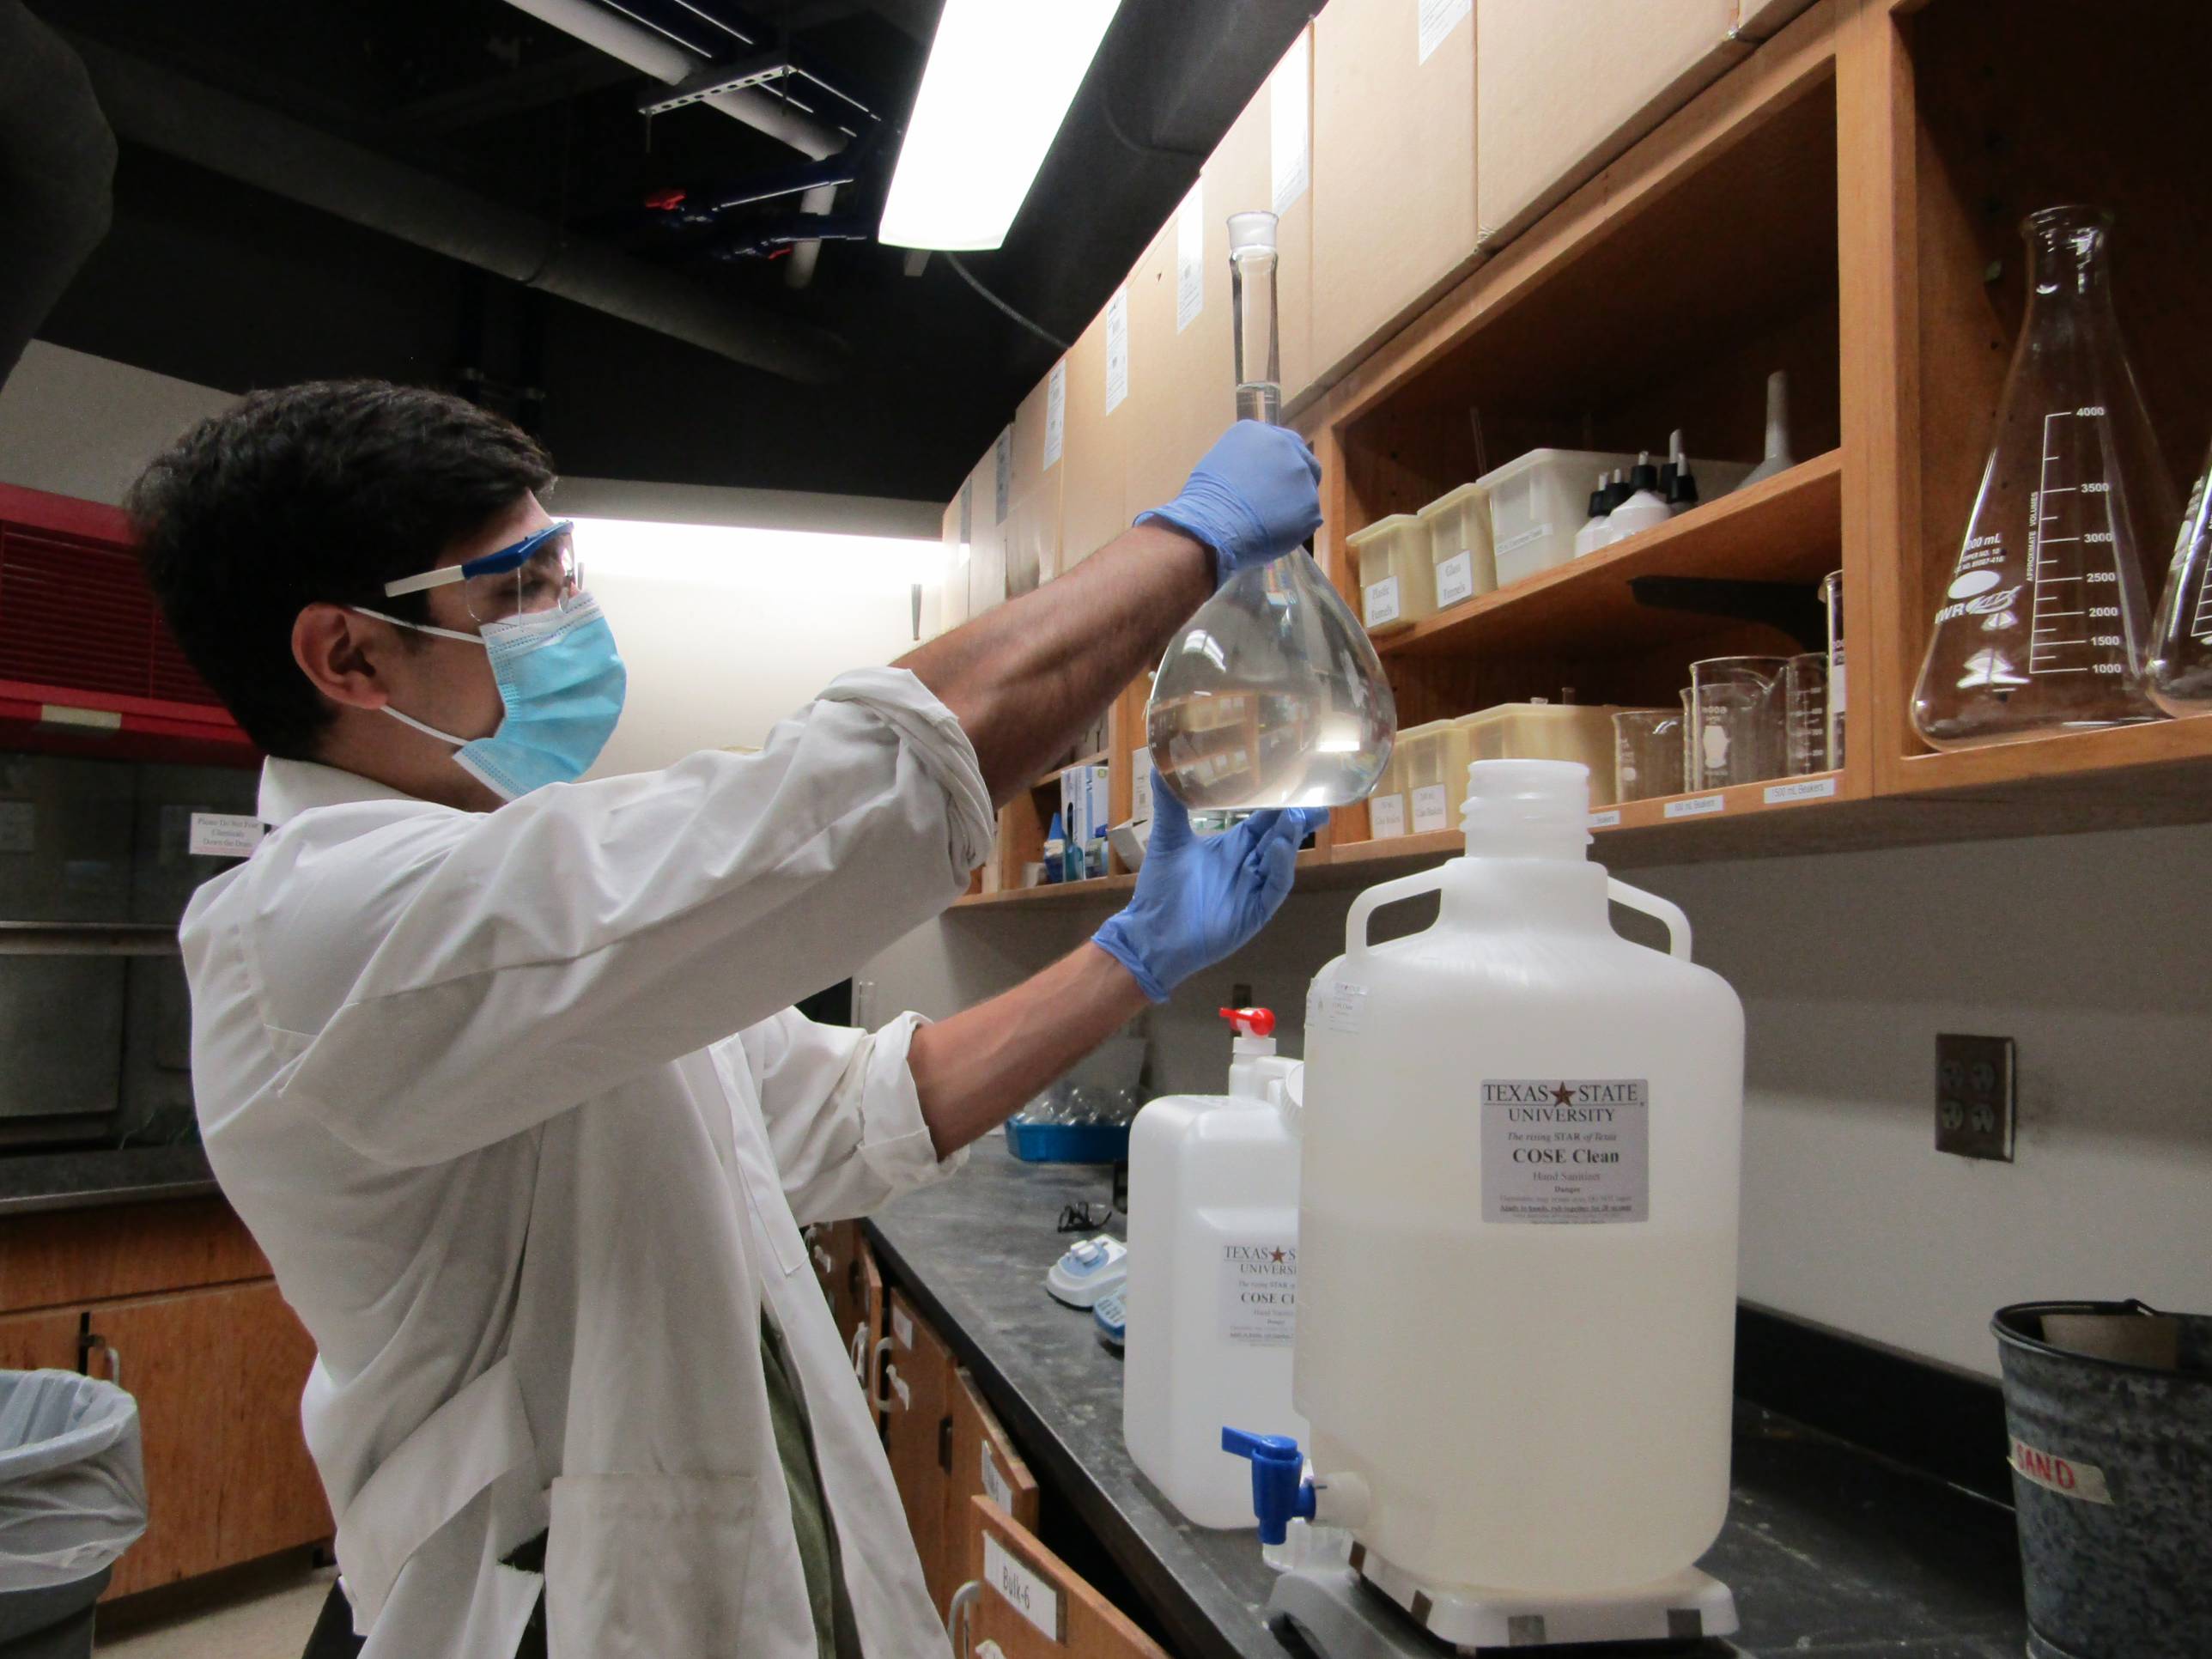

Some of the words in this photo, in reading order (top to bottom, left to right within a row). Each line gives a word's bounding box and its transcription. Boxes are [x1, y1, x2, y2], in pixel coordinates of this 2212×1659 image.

[2076, 407, 2105, 416] 4000
[2081, 483, 2109, 493] 3500
[2029, 491, 2039, 526] VOLUMES
[2084, 533, 2112, 543] 3000
[2027, 531, 2036, 581] APPROXIMATE
[2087, 573, 2116, 582] 2500
[2089, 607, 2118, 617] 2000
[2090, 636, 2120, 647] 1500
[2092, 664, 2121, 673] 1000
[1799, 783, 1824, 794] Beakers
[1484, 1084, 1548, 1102] TEXAS
[1579, 1084, 1638, 1102] STATE
[1509, 1108, 1615, 1123] UNIVERSITY
[1508, 1132, 1523, 1141] The
[1553, 1132, 1581, 1141] STAR
[1513, 1148, 1567, 1164] COSE
[1572, 1148, 1620, 1164] Clean
[1224, 1245, 1268, 1260] TEXAS
[1241, 1292, 1277, 1304] COSE
[2016, 1443, 2076, 1490] SAND
[1002, 1565, 1030, 1609] Bulk-6
